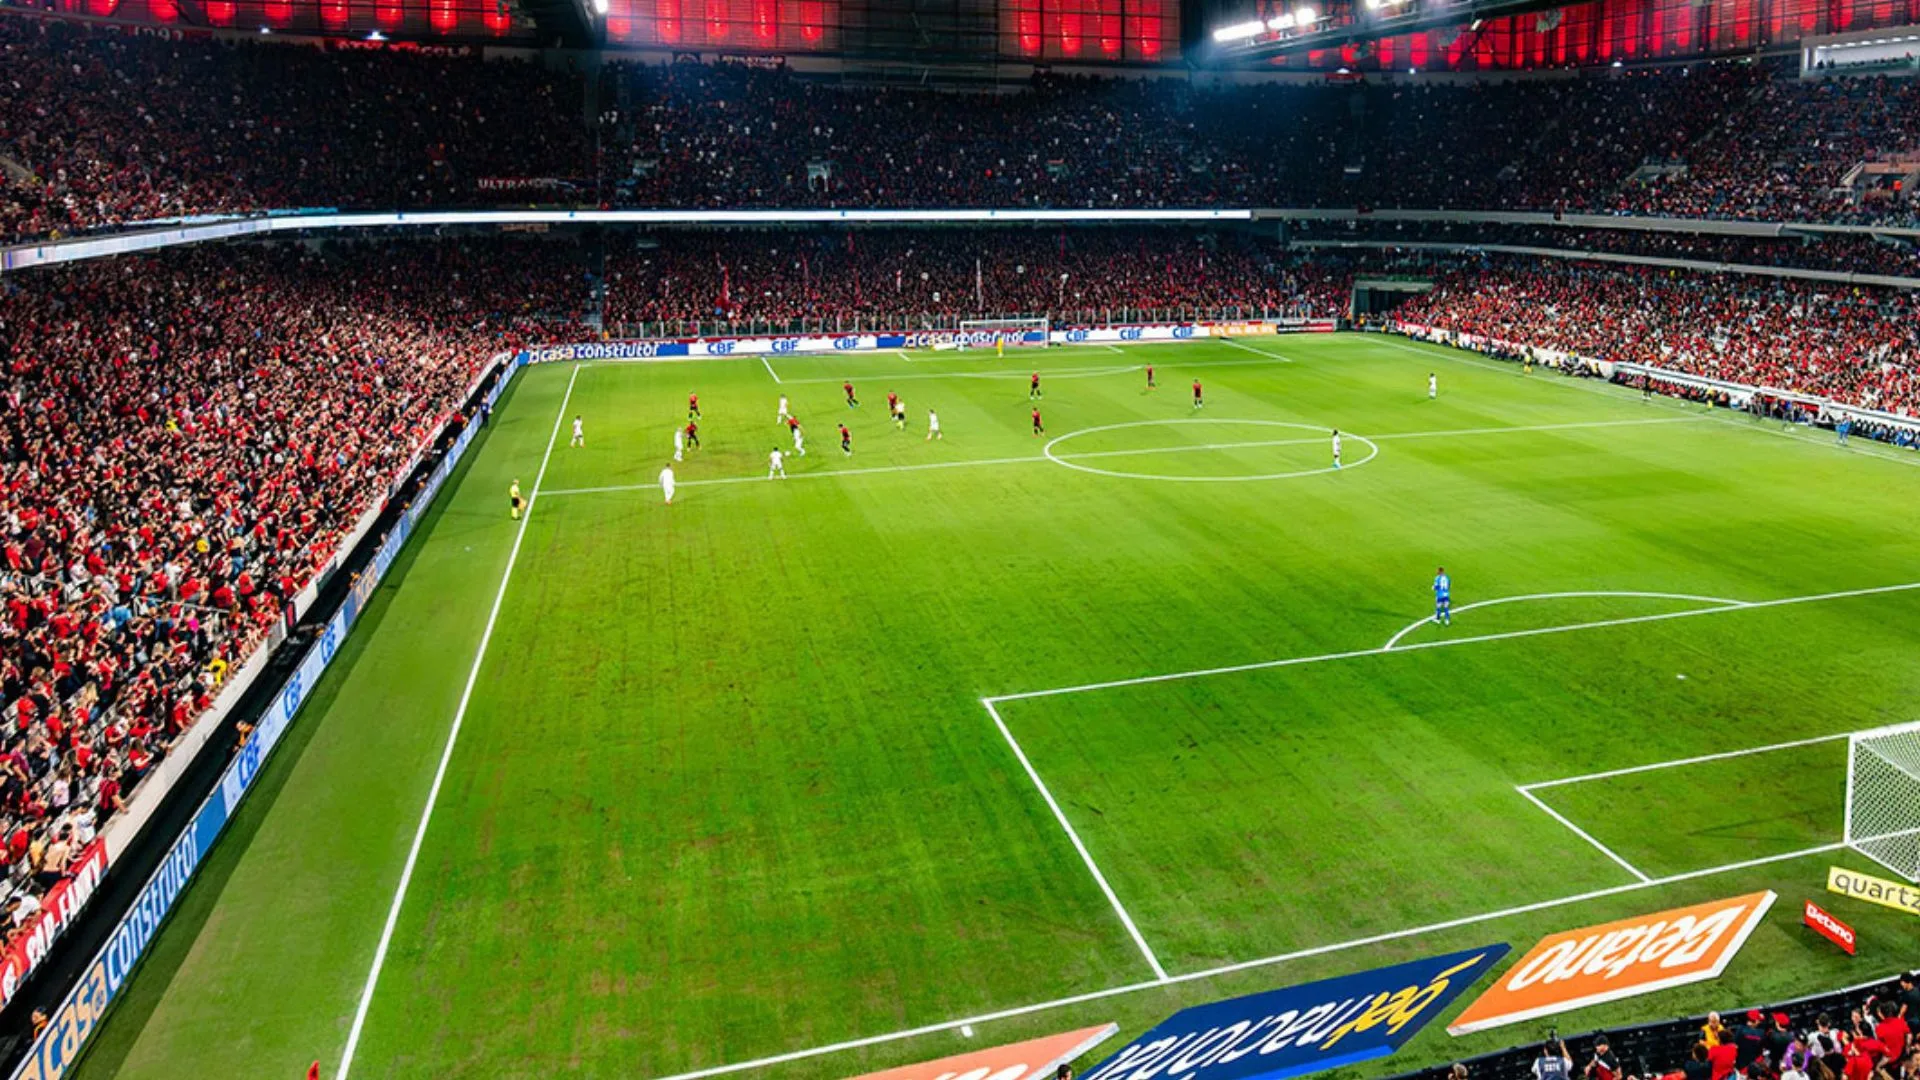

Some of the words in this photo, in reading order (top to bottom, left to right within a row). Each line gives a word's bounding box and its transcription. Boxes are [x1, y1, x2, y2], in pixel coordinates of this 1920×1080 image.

[1066, 330, 1089, 342] CBF
[1119, 328, 1143, 340] CBF
[1172, 325, 1195, 338] CBF
[576, 341, 658, 358] construtor
[707, 342, 735, 354] CBF
[771, 339, 799, 352] CBF
[833, 337, 859, 350] CBF
[283, 671, 302, 720] CBF
[238, 731, 260, 789] CBF
[1835, 873, 1920, 909] quartz
[107, 821, 199, 992] construtor
[1806, 903, 1853, 944] Betano
[1507, 903, 1748, 991] Betano
